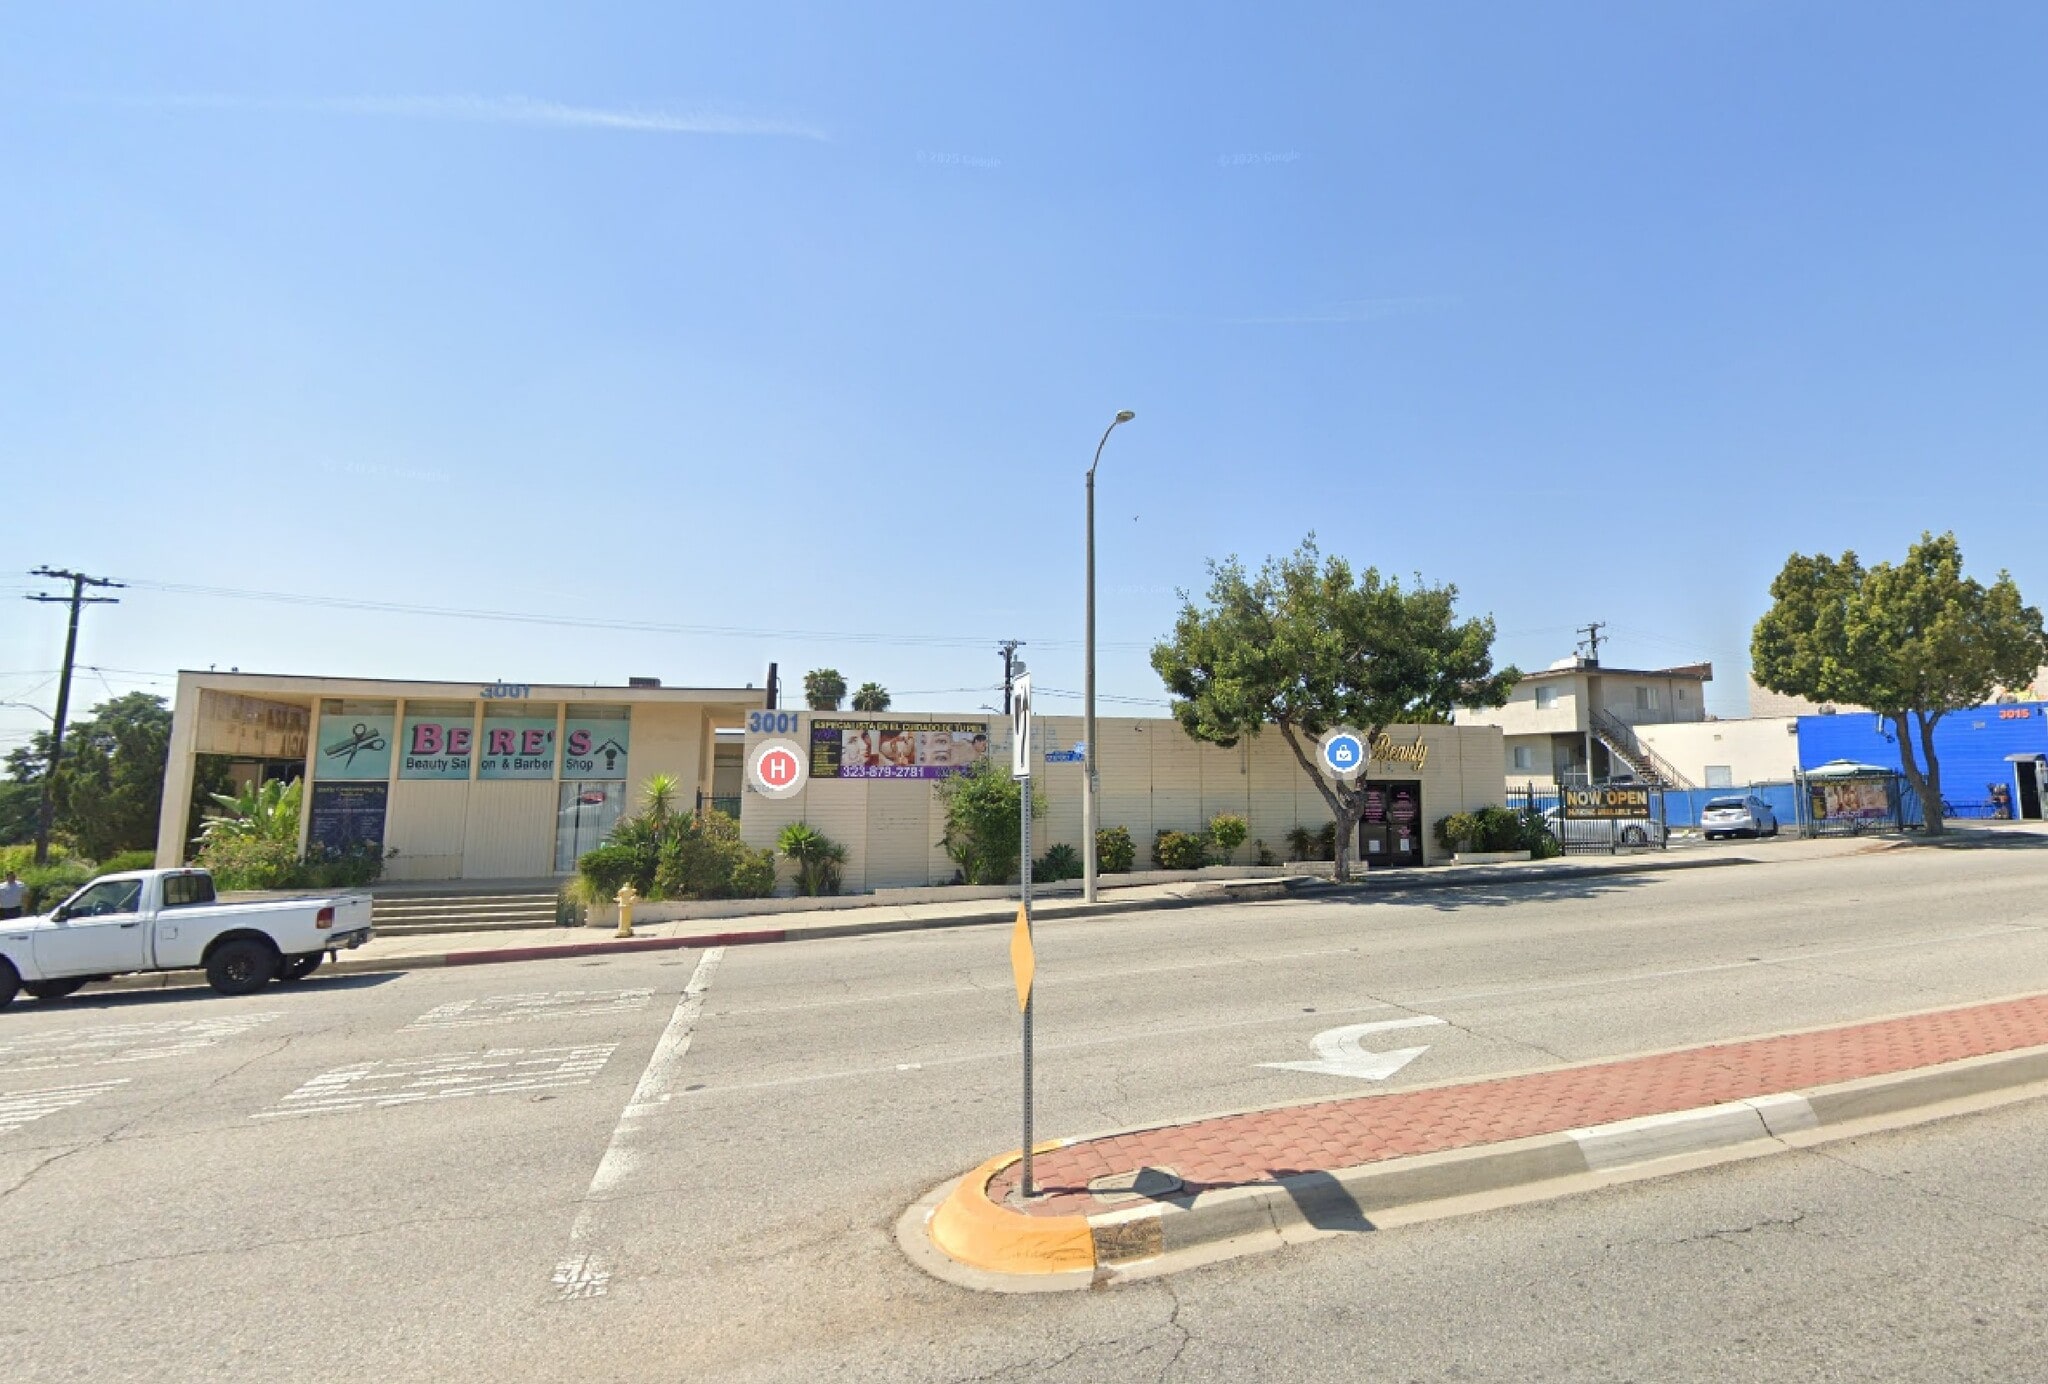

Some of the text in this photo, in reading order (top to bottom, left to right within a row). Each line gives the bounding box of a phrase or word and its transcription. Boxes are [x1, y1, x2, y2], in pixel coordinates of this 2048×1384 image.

[2000, 708, 2030, 719] 3015
[750, 712, 798, 733] 3001
[1371, 732, 1428, 770] Beauty
[406, 757, 448, 772] Beauty
[502, 758, 509, 770] &
[514, 758, 553, 770] Barber
[566, 758, 593, 772] Shop
[843, 766, 924, 778] 323-879-2781
[1567, 791, 1647, 805] NOW OPEN
